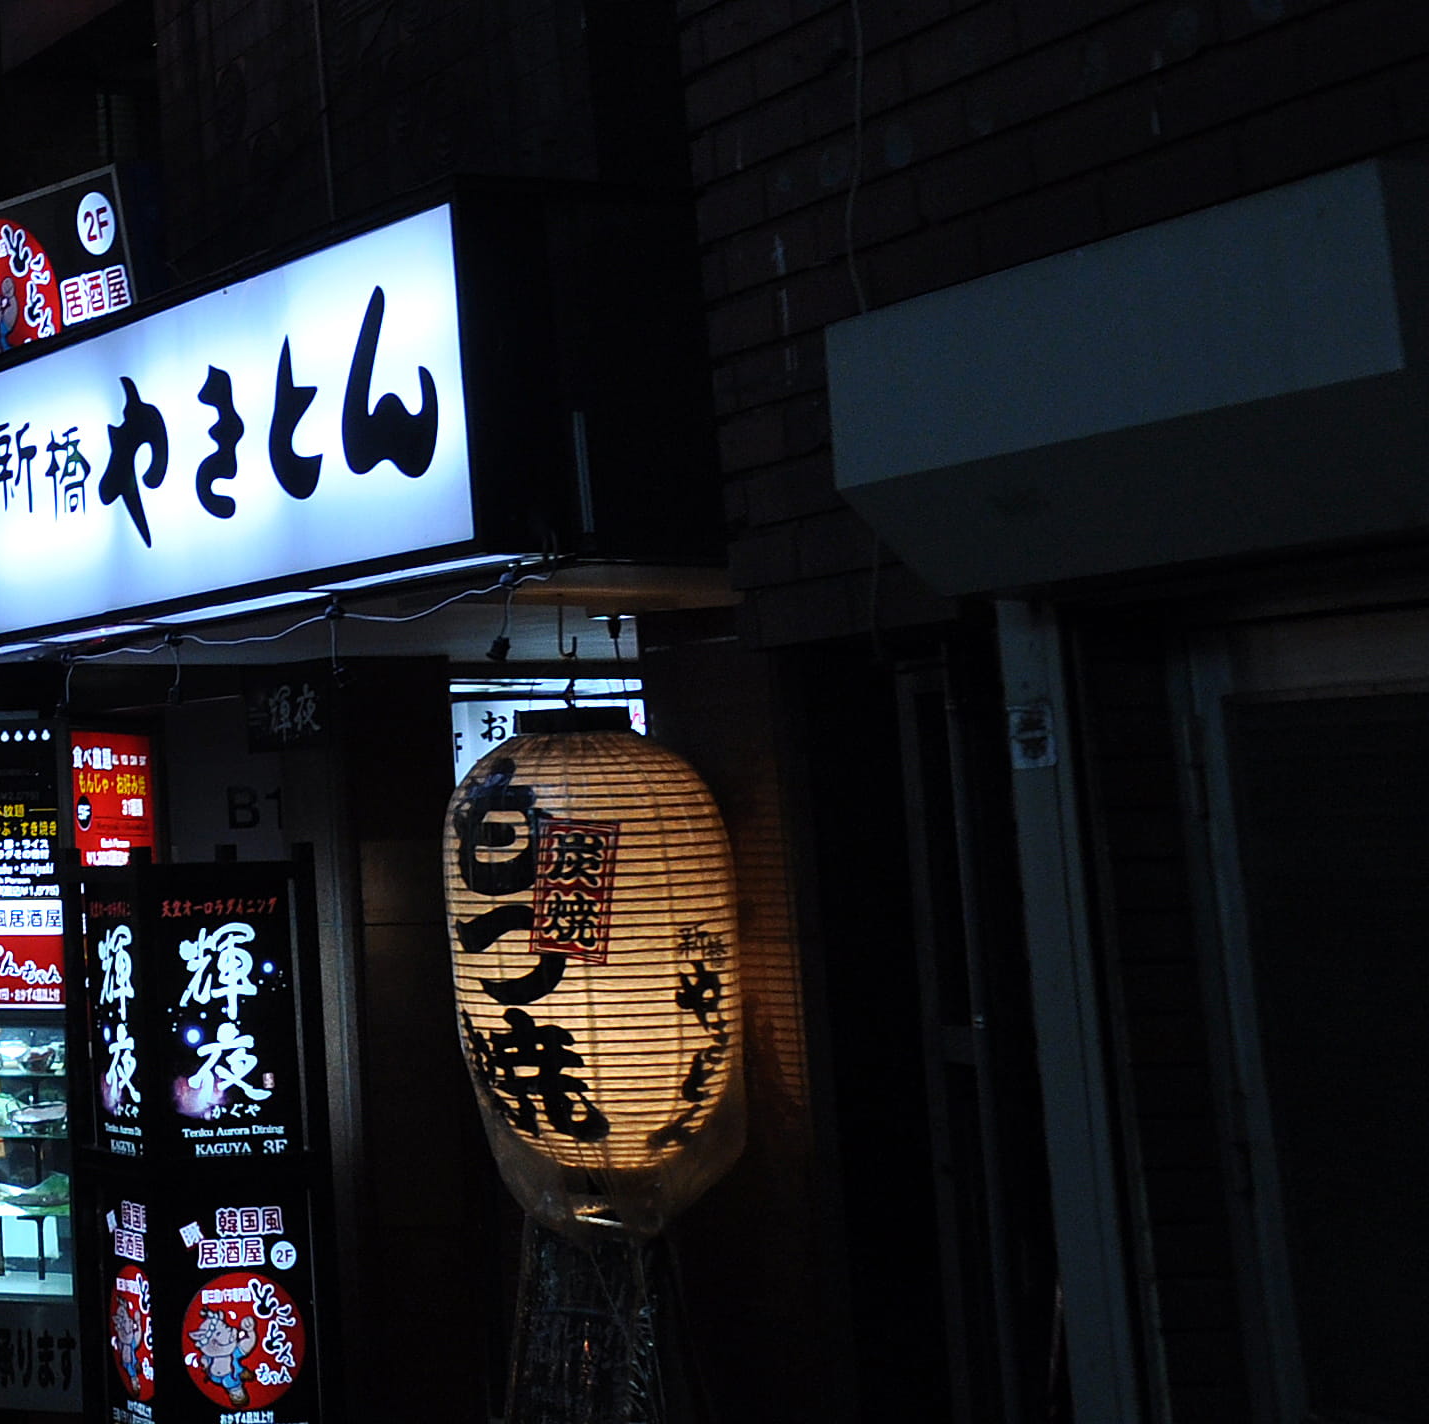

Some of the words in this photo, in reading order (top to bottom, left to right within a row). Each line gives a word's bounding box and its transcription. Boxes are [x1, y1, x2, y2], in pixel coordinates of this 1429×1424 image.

[83, 206, 111, 242] 2F
[59, 264, 133, 326] 居酒屋
[98, 285, 439, 548] やきとん
[227, 785, 285, 830] B1
[179, 922, 273, 1101] 輝夜
[195, 1142, 253, 1156] KAGUYA
[215, 1205, 285, 1237] 韓国風
[197, 1237, 266, 1270] 居酒屋
[275, 1248, 293, 1264] 2F
